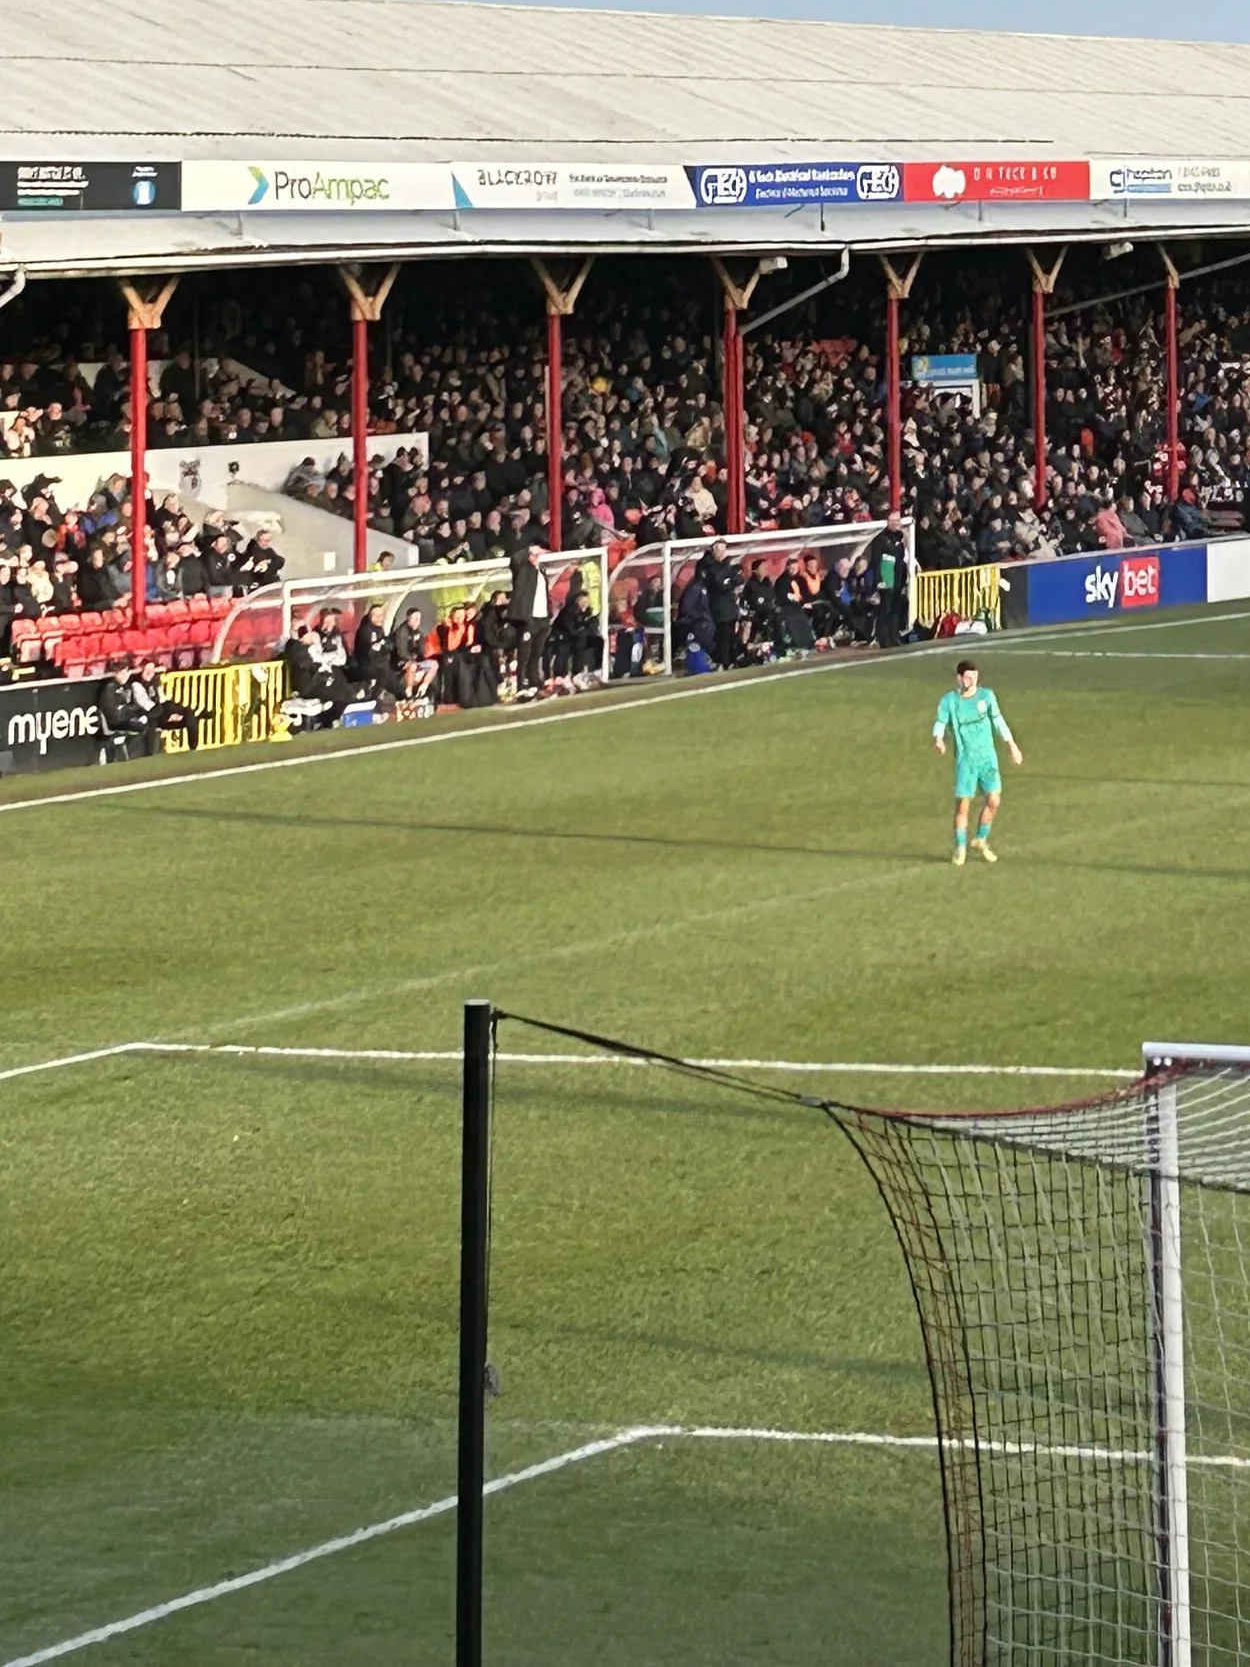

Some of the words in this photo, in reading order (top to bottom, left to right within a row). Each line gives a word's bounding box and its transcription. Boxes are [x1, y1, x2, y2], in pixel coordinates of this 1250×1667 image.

[275, 170, 390, 206] ProAmpac
[1084, 565, 1119, 608] sky
[1122, 561, 1159, 597] bet
